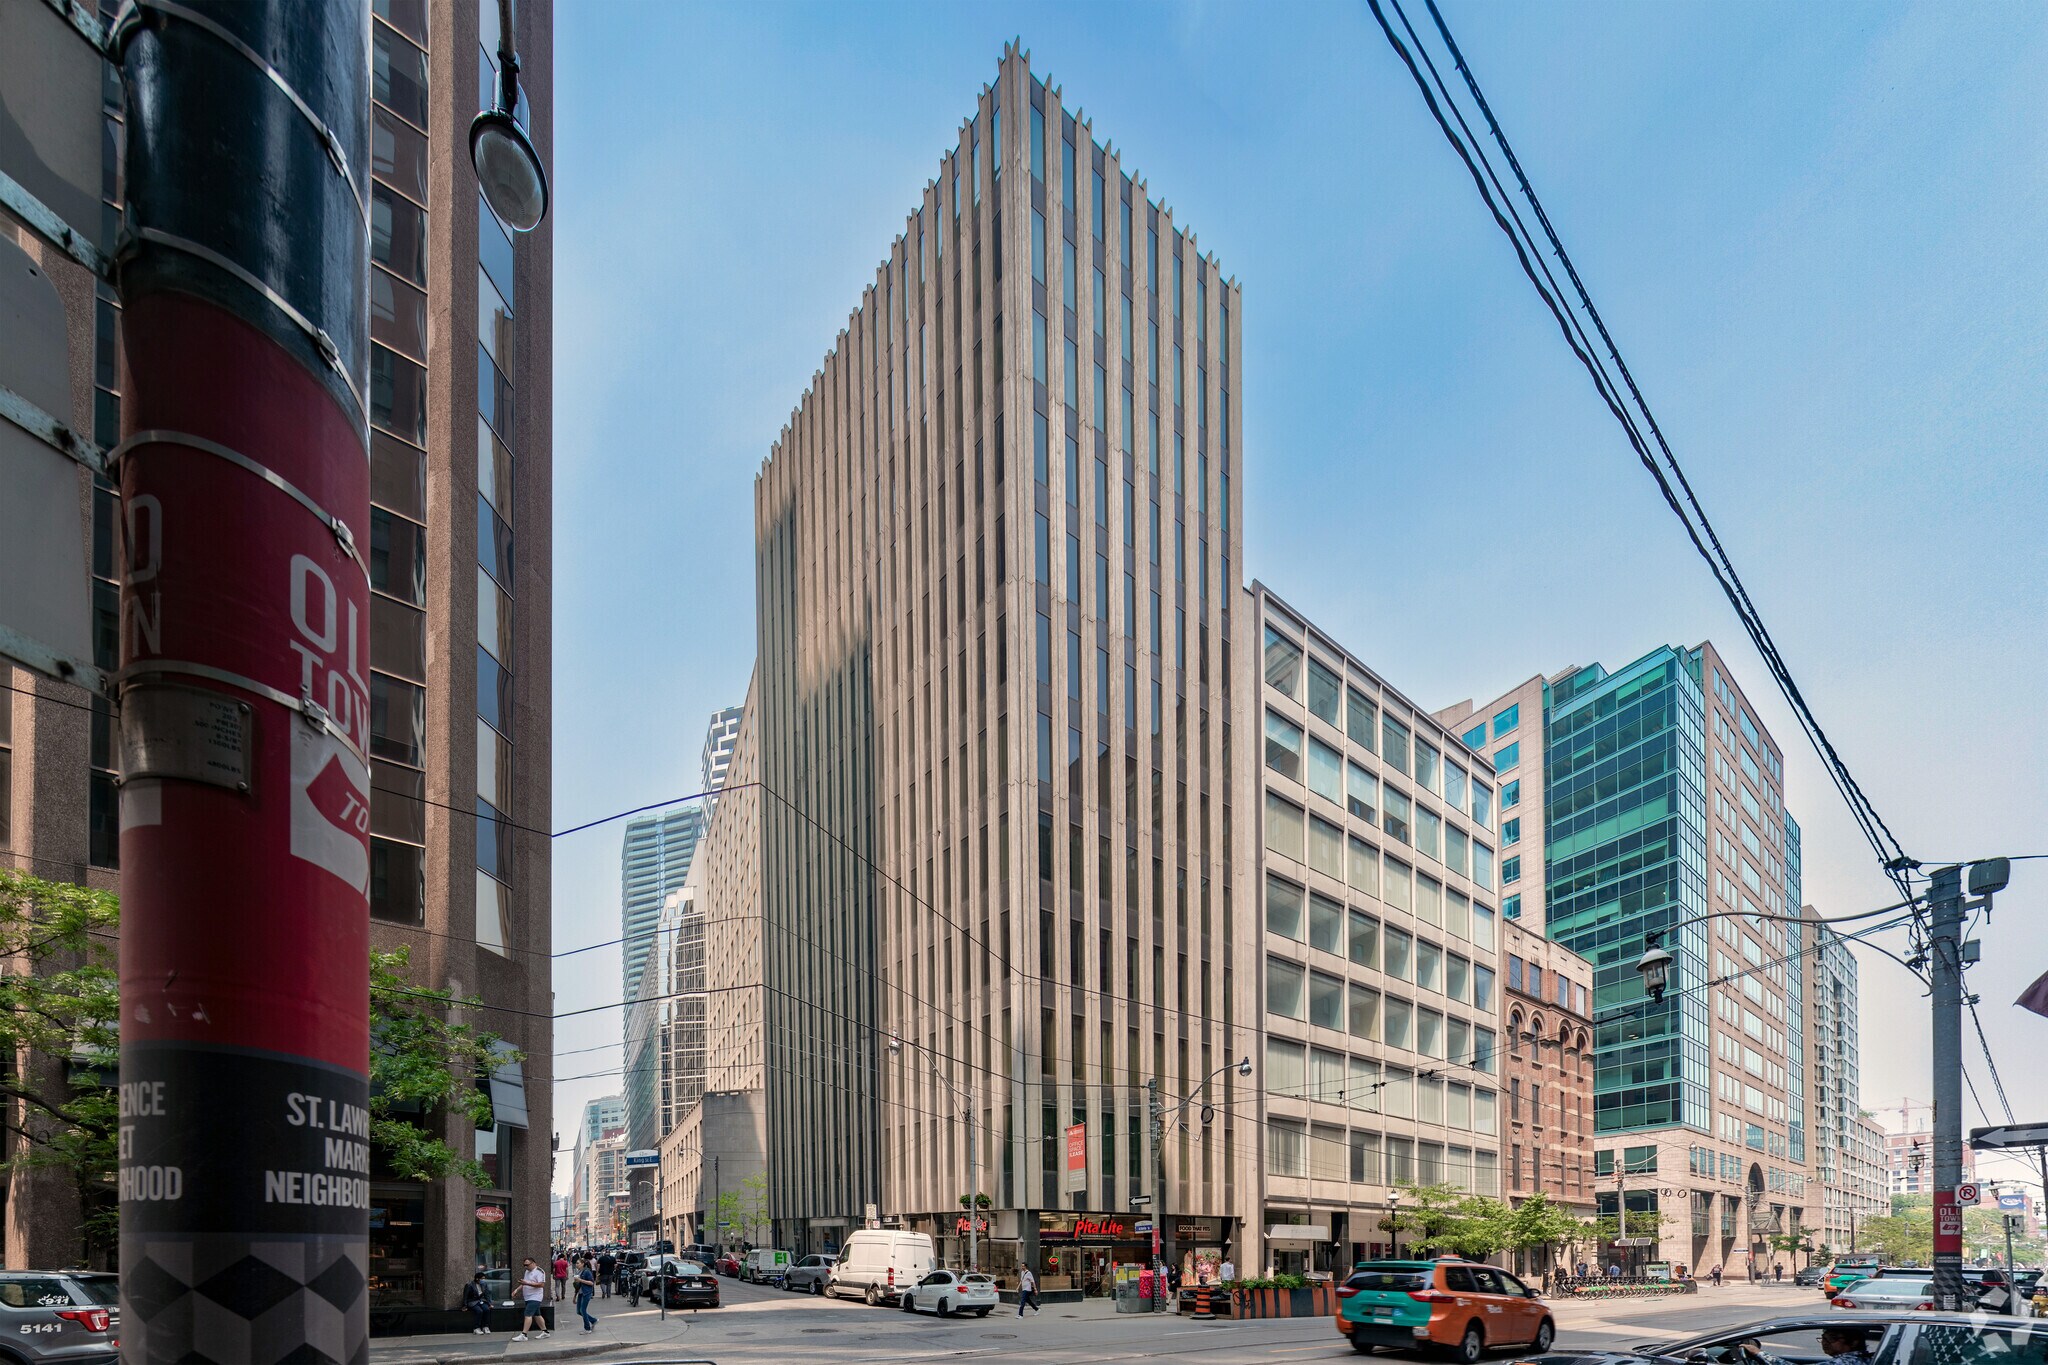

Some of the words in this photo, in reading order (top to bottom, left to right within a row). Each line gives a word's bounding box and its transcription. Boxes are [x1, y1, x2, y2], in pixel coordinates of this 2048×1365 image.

[286, 1092, 325, 1129] ST.
[1939, 1207, 1961, 1216] OLD
[1074, 1219, 1099, 1238] Pita
[1101, 1219, 1123, 1235] Lite
[45, 1297, 70, 1305] 911
[20, 1323, 62, 1334] 5141
